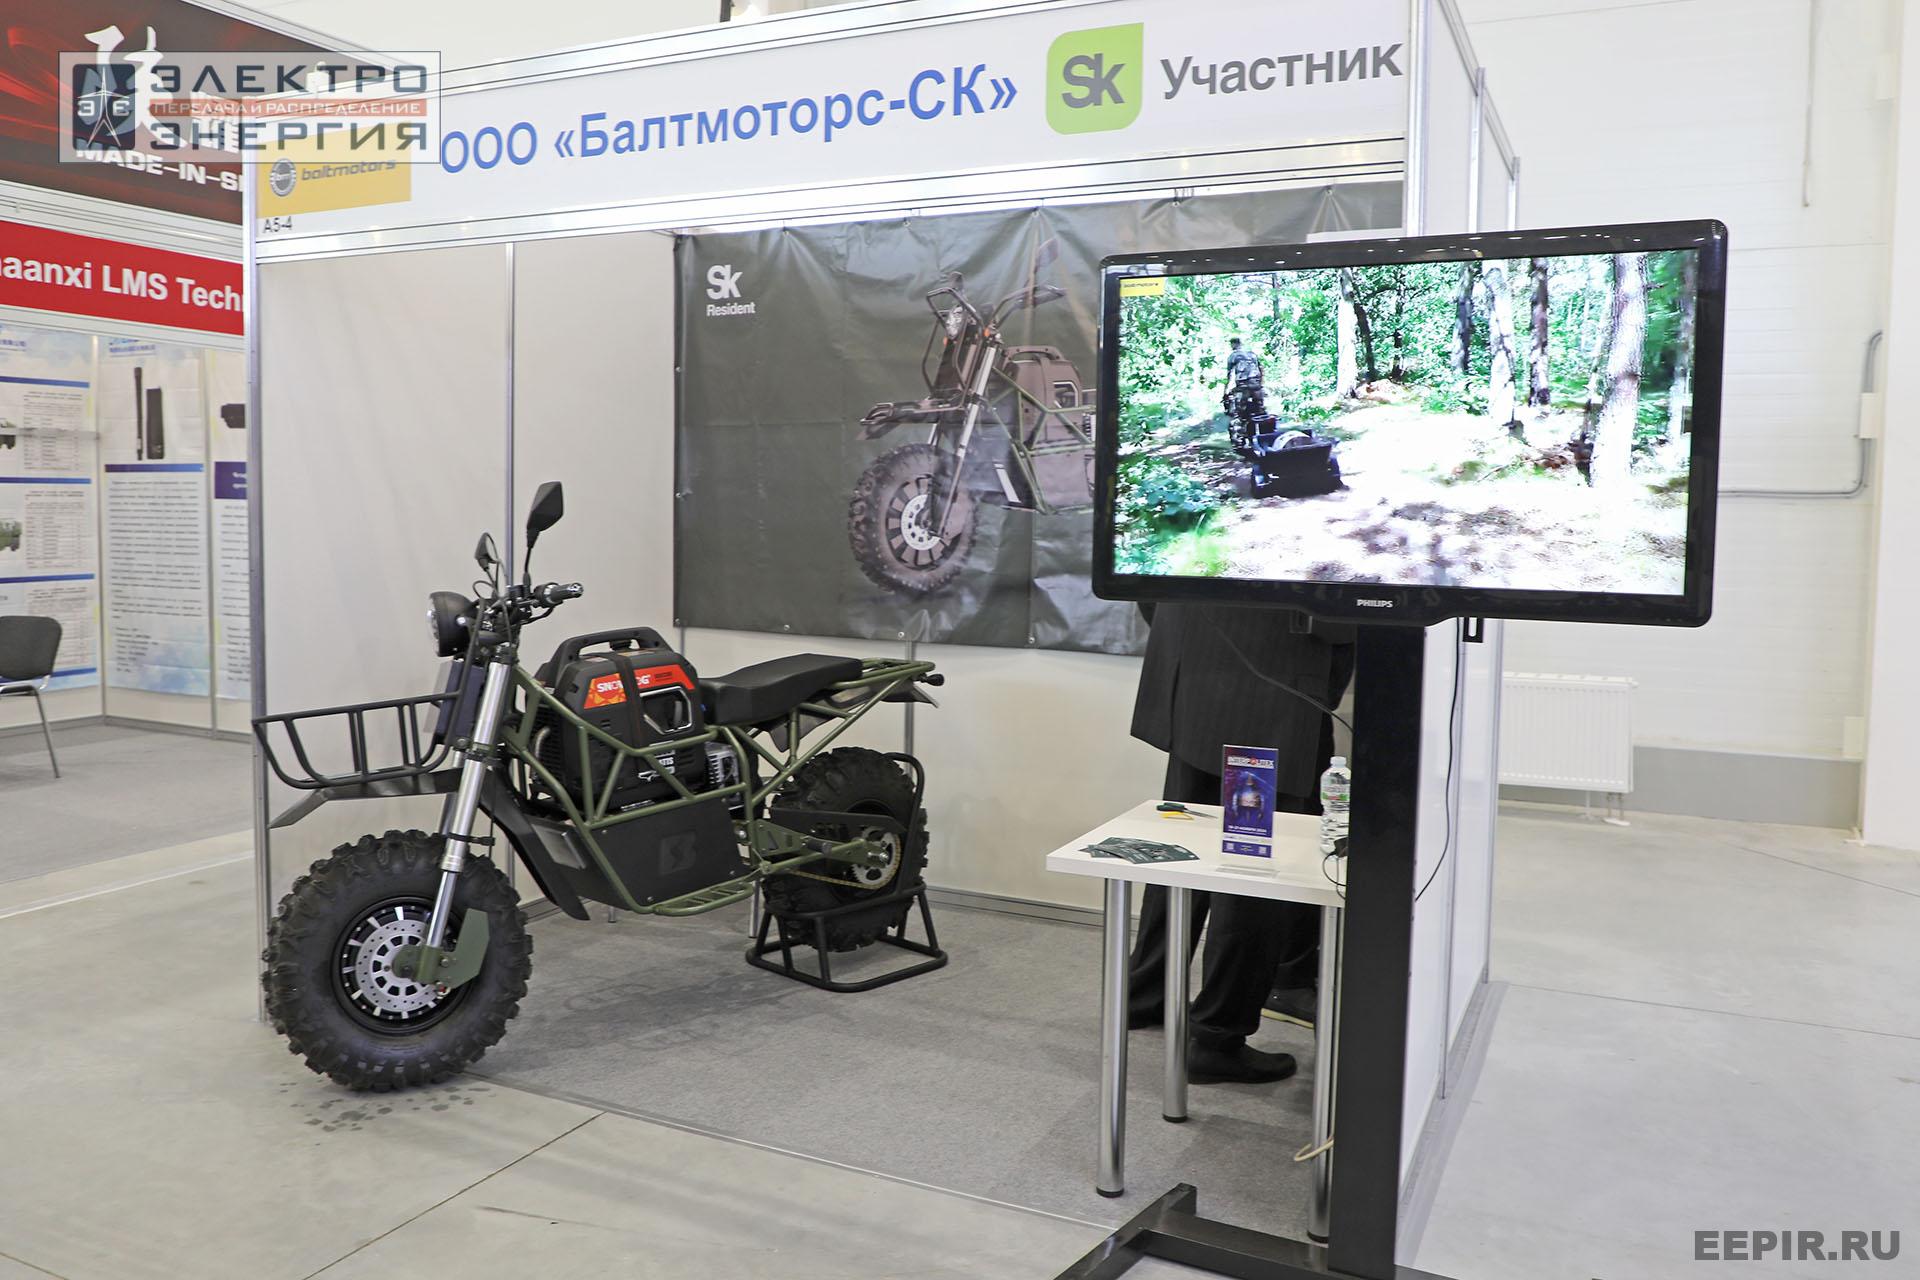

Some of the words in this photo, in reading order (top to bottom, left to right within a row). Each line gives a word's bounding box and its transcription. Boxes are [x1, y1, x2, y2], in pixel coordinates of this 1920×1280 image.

[1062, 53, 1125, 109] Sk
[1160, 42, 1404, 100] Участник
[441, 121, 538, 173] ООО
[554, 63, 1018, 158] «Балтмоторс-СК»
[262, 215, 292, 233] A5-4
[0, 256, 92, 290] aanxi
[102, 264, 168, 301] LMS
[175, 276, 243, 312] Tech
[706, 264, 743, 300] Sk
[706, 301, 756, 317] Resident
[1357, 599, 1393, 608] PHILIPS
